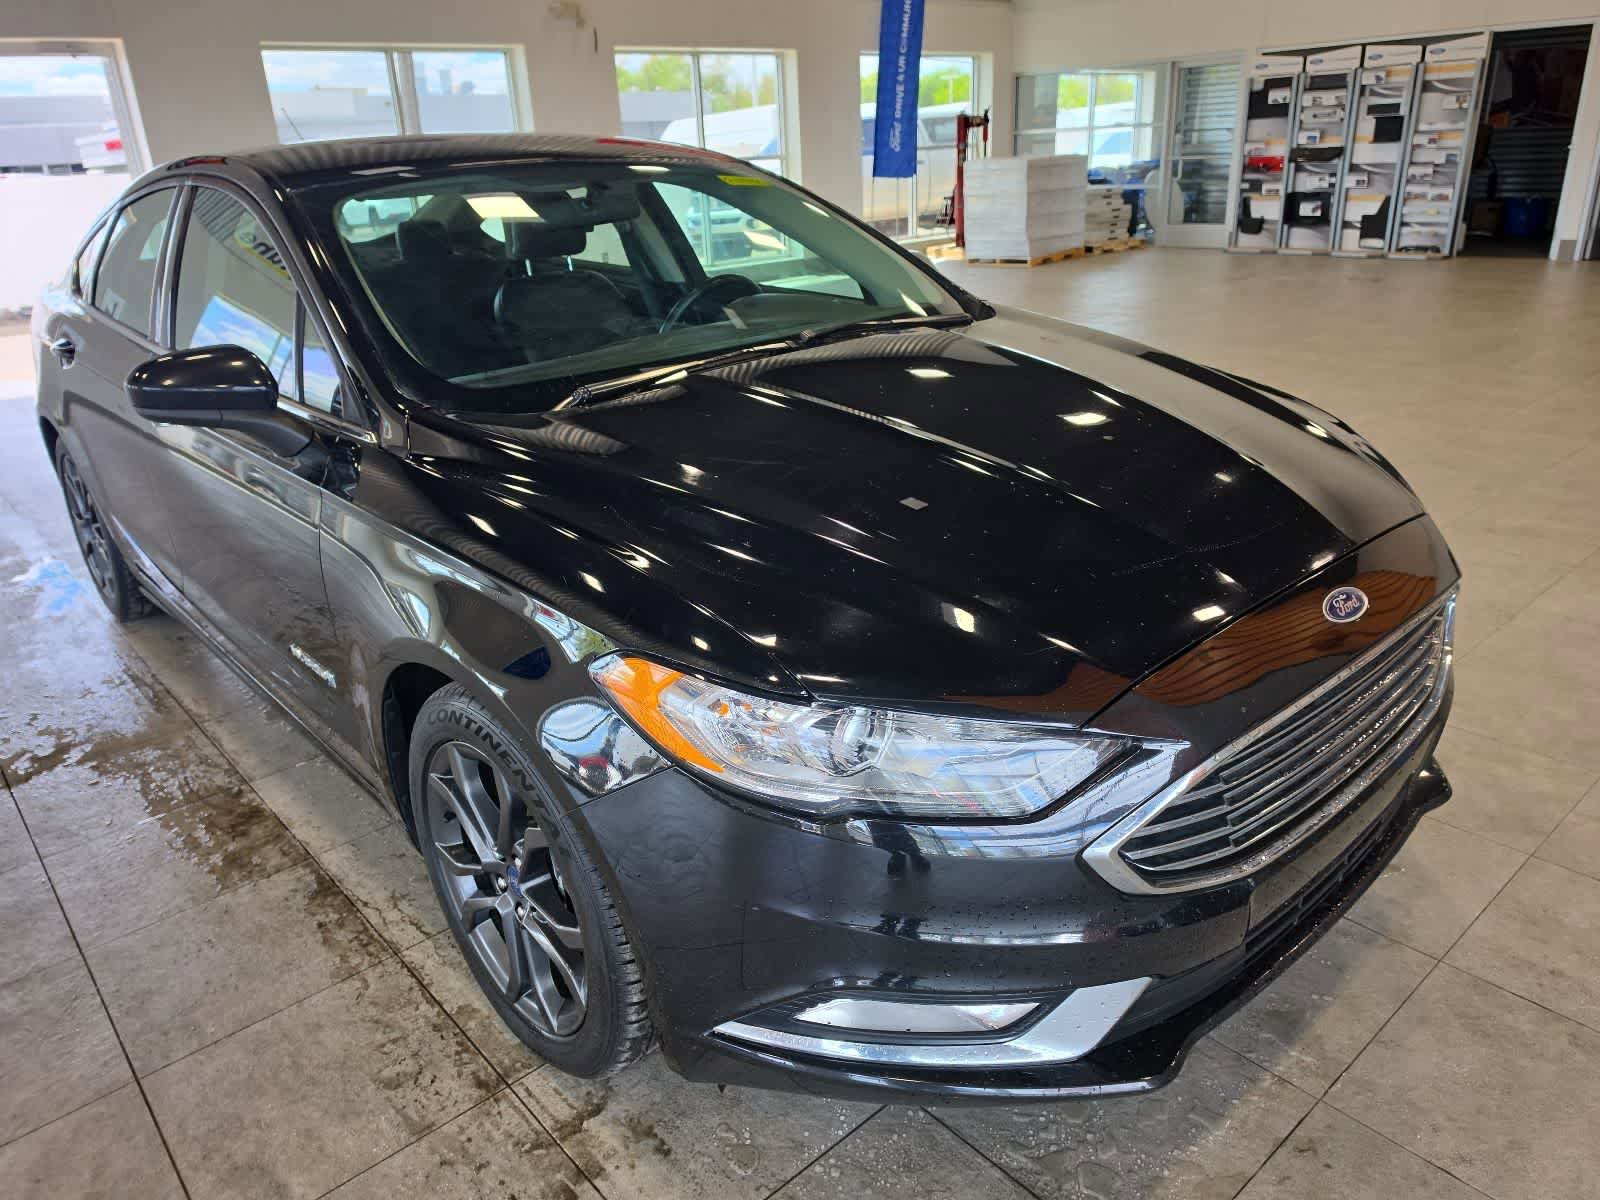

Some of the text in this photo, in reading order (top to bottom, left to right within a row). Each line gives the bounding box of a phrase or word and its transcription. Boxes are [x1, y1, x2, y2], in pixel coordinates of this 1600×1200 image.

[898, 55, 907, 73] UR
[895, 84, 905, 118] DRIVE
[889, 121, 902, 152] Ford
[1331, 592, 1361, 617] Ford
